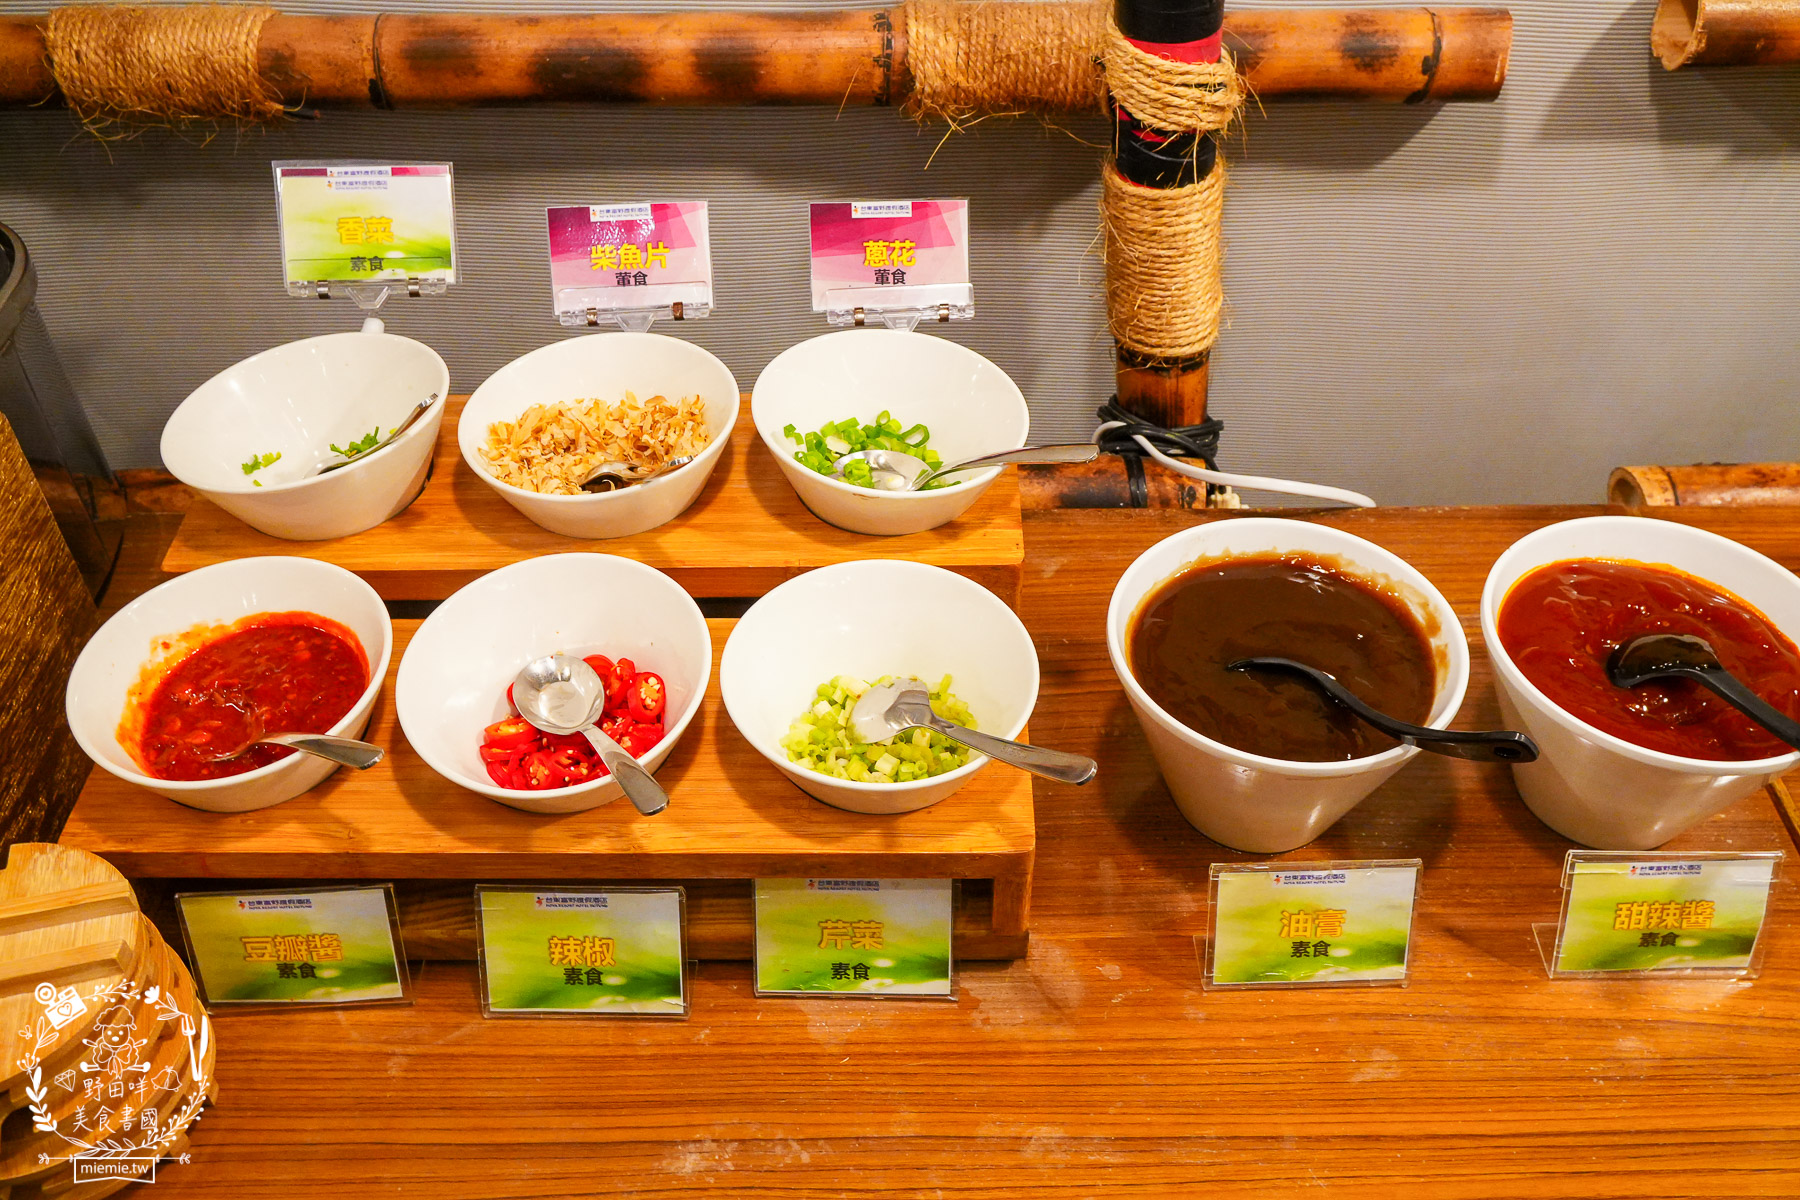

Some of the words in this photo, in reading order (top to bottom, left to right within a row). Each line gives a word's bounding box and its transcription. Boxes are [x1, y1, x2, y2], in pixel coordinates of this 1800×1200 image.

[337, 216, 394, 245] 香菜
[350, 256, 384, 272] 素食
[590, 241, 671, 271] 柴魚片
[863, 239, 916, 267] 蔥花
[615, 270, 648, 286] 葷食
[874, 268, 906, 285] 葷食
[1279, 908, 1347, 938] 油膏
[1613, 899, 1716, 930] 甜辣醬
[818, 919, 884, 950] 芹菜
[1638, 931, 1680, 948] 素食
[240, 933, 343, 962] 豆瓣醬
[548, 935, 616, 967] 辣椒
[1290, 940, 1331, 958] 素食
[276, 962, 317, 979] 素食
[563, 967, 603, 986] 素食
[831, 962, 870, 980] 素食
